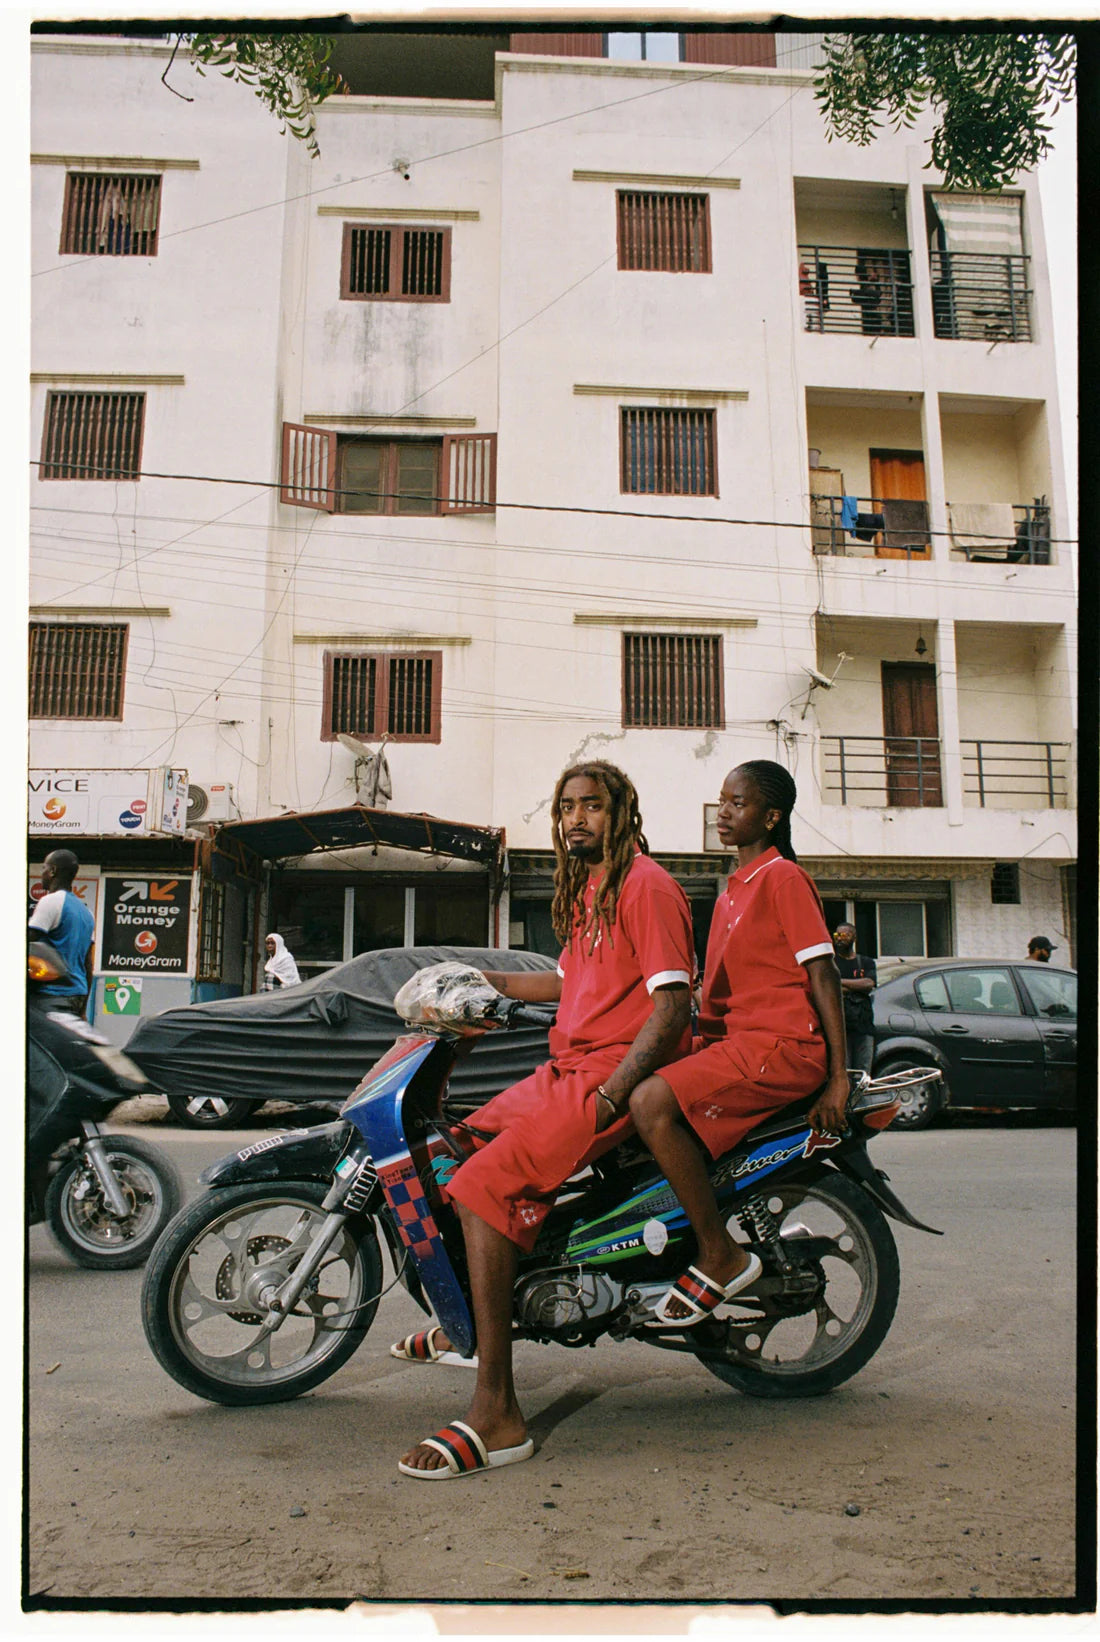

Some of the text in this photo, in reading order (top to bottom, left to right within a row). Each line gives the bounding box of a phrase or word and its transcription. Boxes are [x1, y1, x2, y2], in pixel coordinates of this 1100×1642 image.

[28, 779, 89, 792] VICE
[113, 903, 180, 916] Orange
[116, 914, 176, 928] Money
[108, 954, 182, 968] MoneyGram
[611, 1238, 640, 1252] KTM
